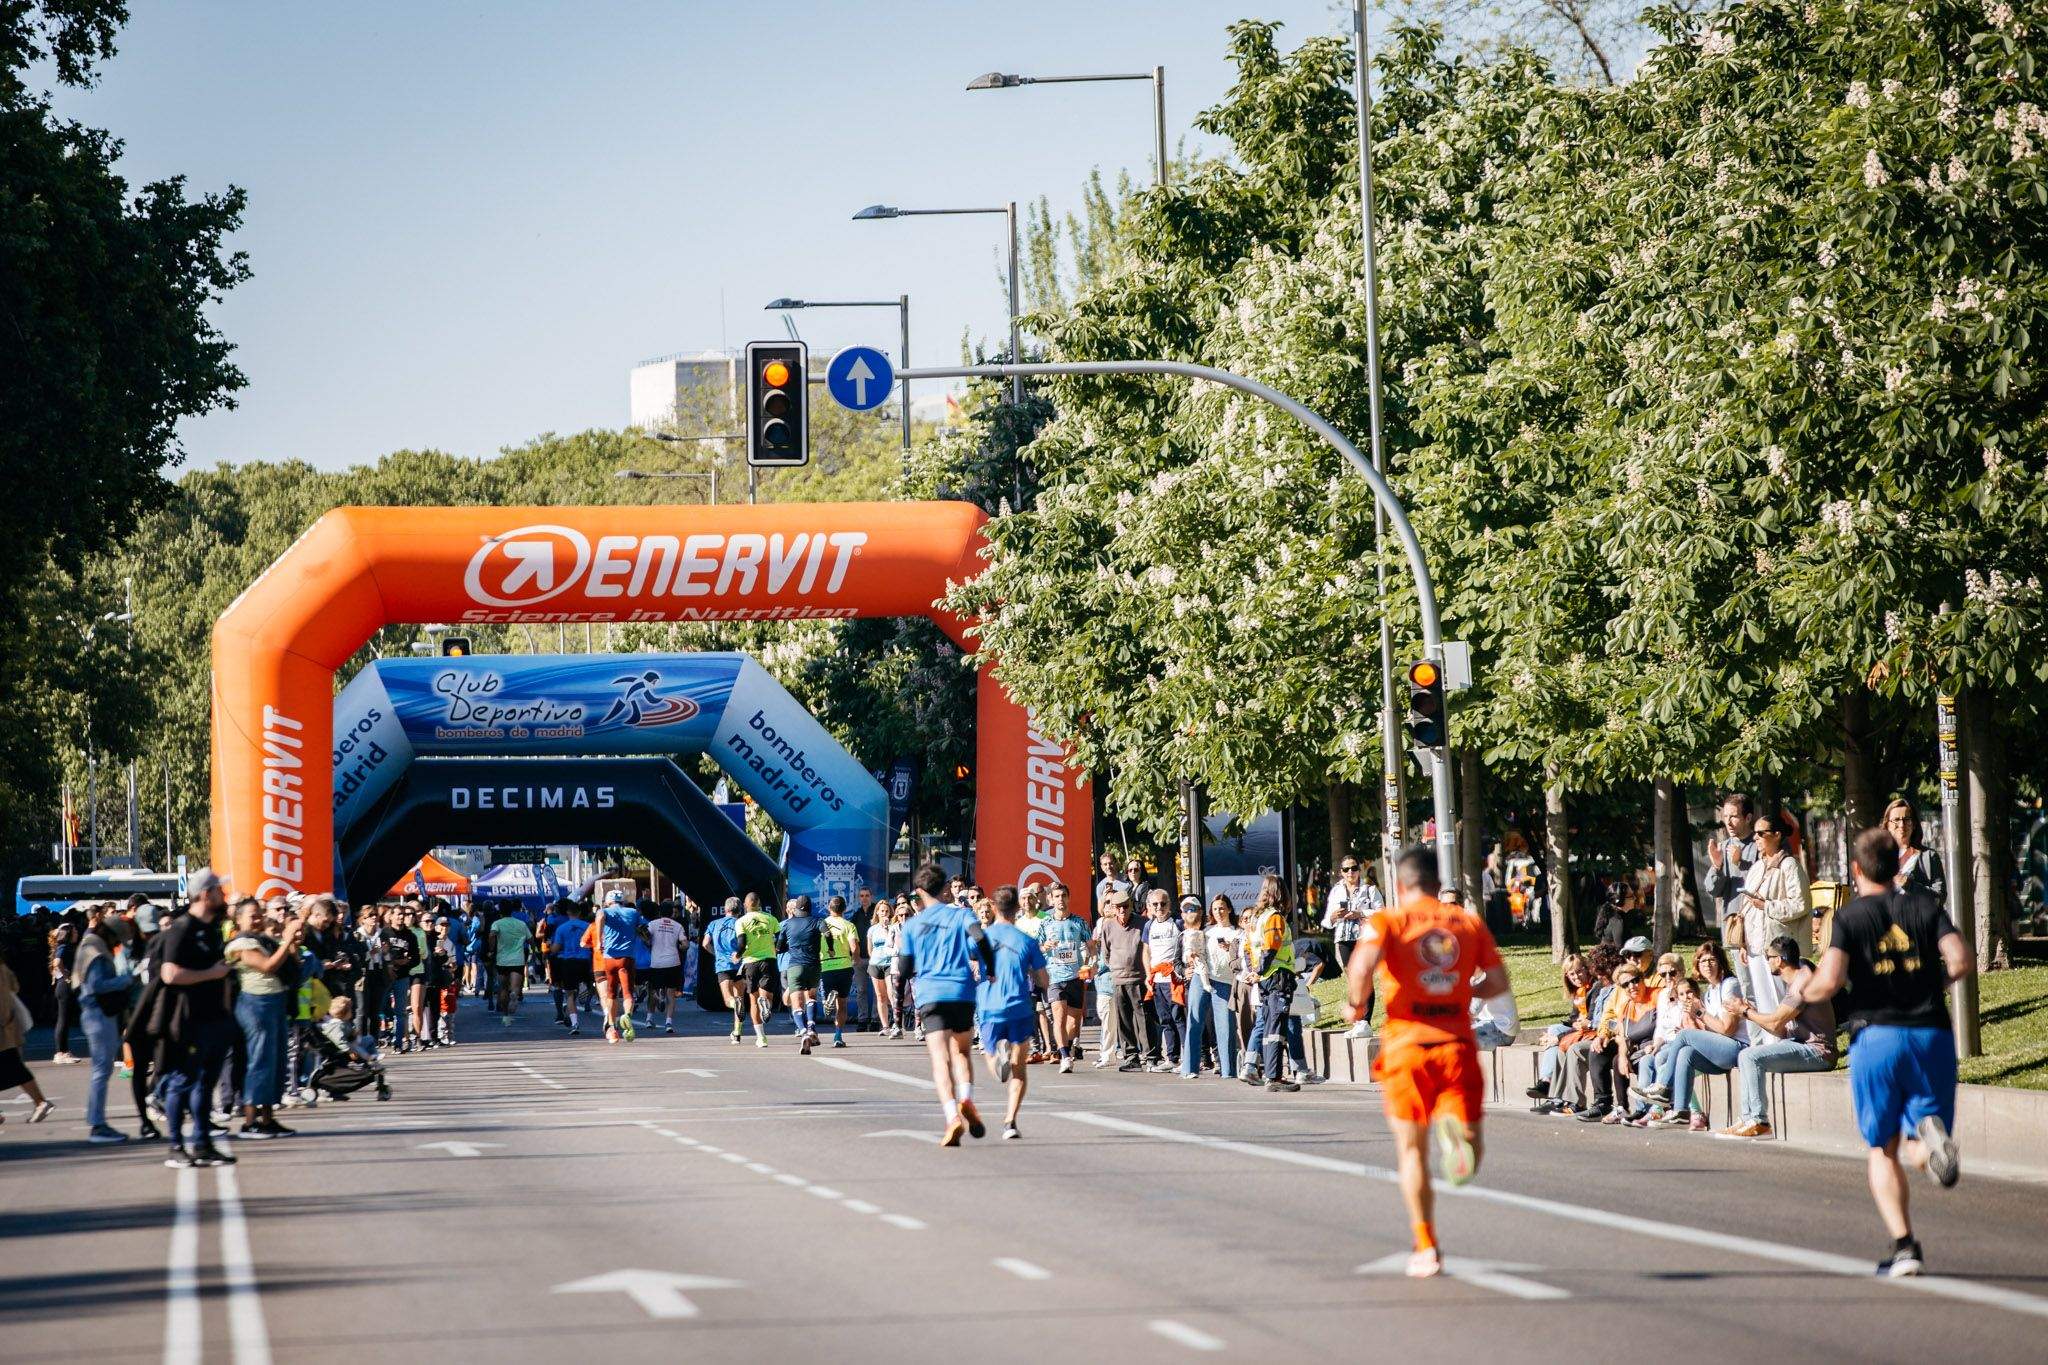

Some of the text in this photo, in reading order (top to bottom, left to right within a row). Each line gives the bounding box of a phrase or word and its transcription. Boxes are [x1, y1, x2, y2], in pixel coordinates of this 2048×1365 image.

[584, 531, 868, 598] ENERVIT
[458, 604, 859, 623] Science in Nutrition
[436, 673, 499, 694] Club
[450, 693, 582, 727] Deportivo
[437, 726, 584, 739] bomberos de madrid
[333, 740, 389, 809] adrid
[727, 733, 812, 814] madrid
[748, 709, 845, 812] bomberos
[262, 704, 303, 882] ENERVIT
[451, 786, 615, 809] DECIMAS
[1027, 704, 1065, 868] ENERV
[816, 853, 862, 863] bomberos
[425, 882, 458, 894] NERVIT
[492, 885, 553, 895] BOMBER
